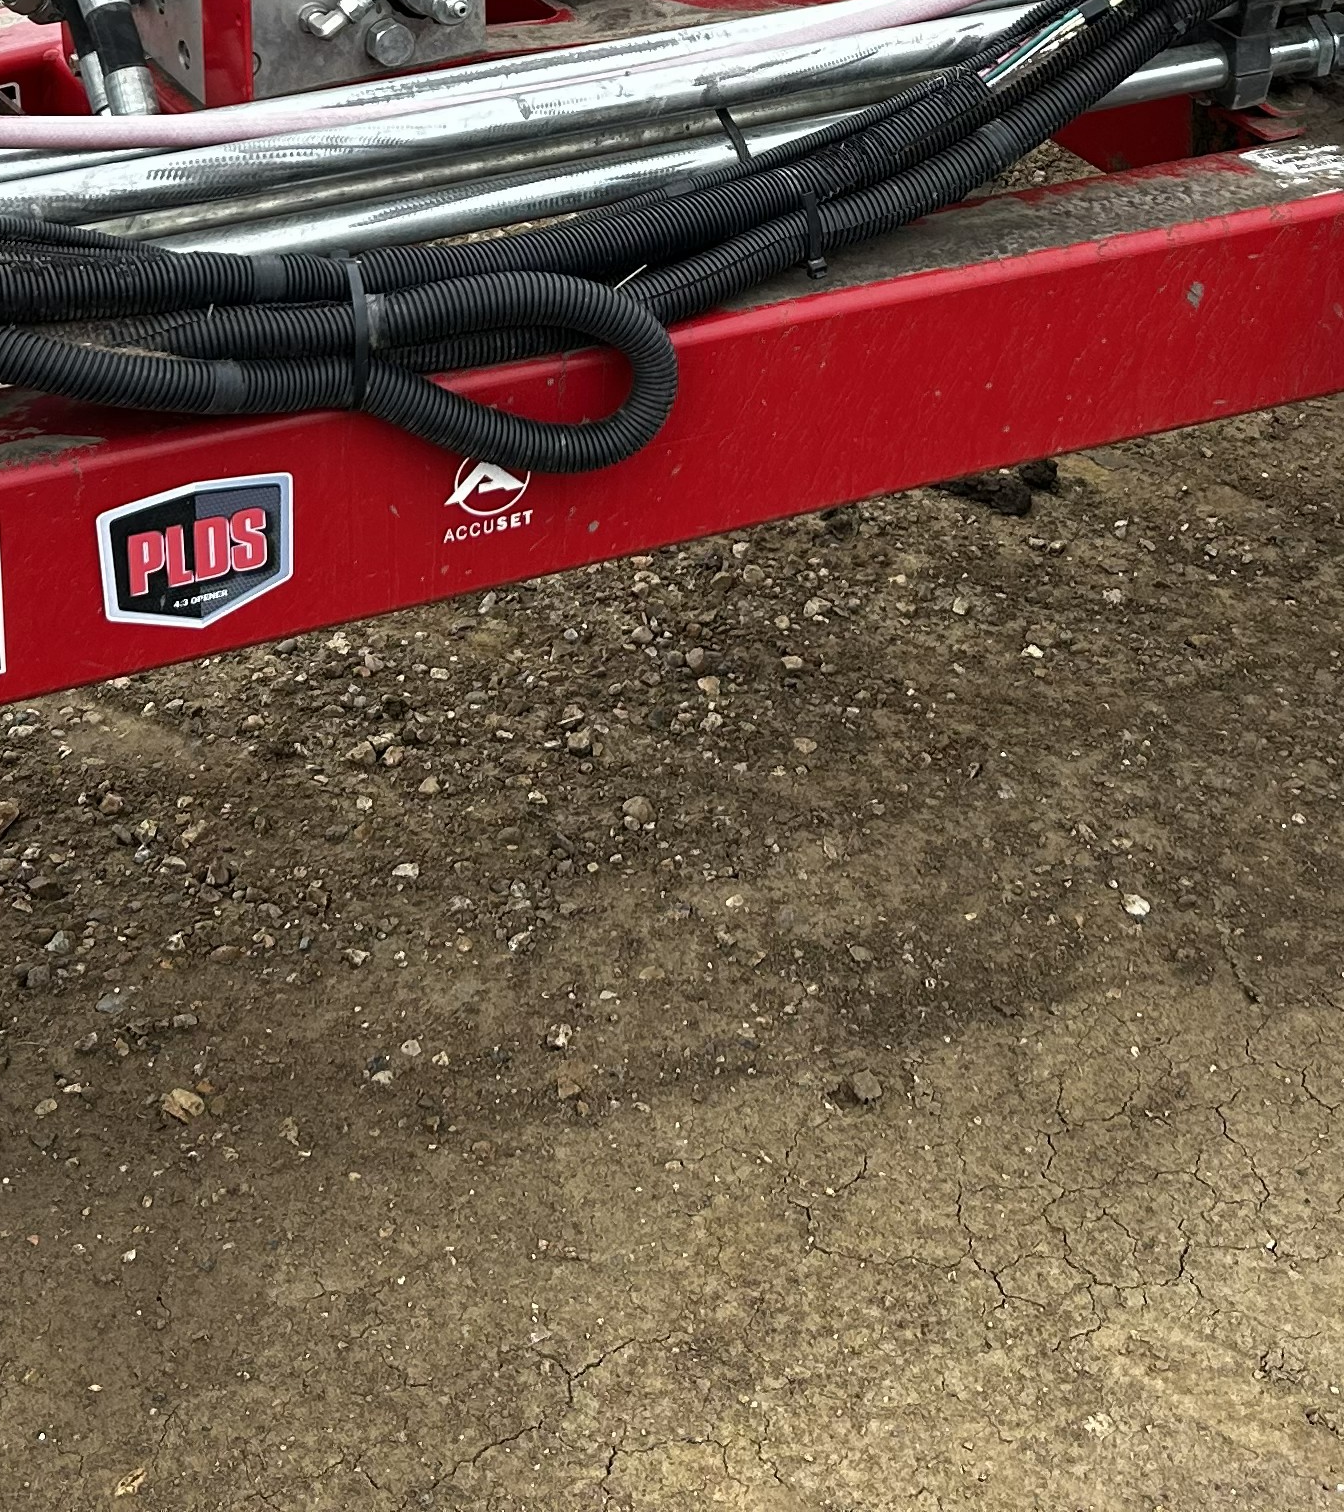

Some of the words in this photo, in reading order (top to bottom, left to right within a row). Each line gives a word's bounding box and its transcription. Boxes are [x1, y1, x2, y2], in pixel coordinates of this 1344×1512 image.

[443, 508, 534, 544] ACCUSET
[127, 506, 268, 597] PLDS
[190, 589, 228, 605] OPENER
